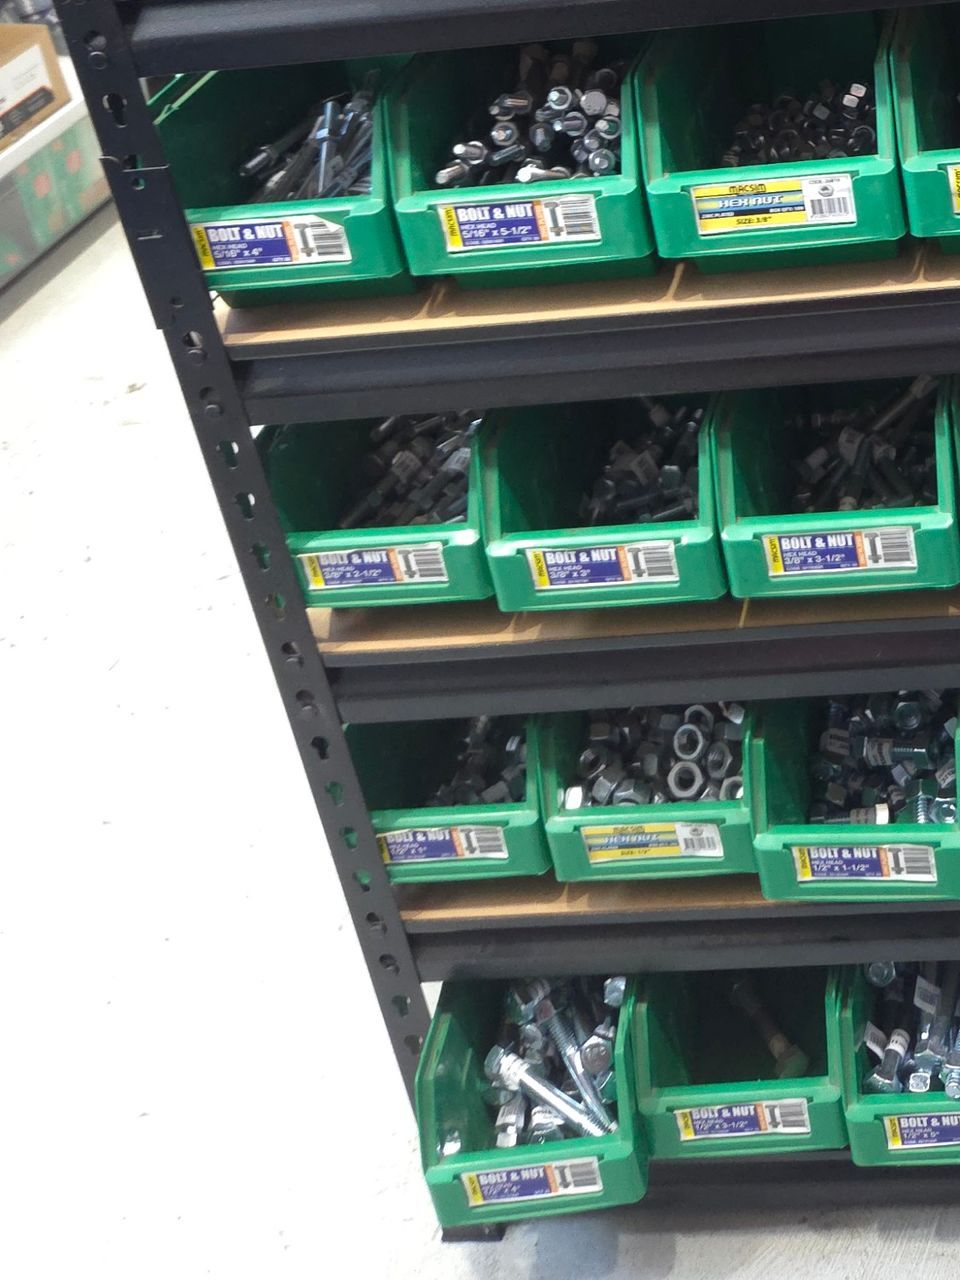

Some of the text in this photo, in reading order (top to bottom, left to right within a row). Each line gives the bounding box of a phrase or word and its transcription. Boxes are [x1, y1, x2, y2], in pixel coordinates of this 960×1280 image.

[718, 193, 783, 208] HEX NUT
[457, 203, 533, 222] BOLT & NUT
[207, 223, 283, 242] BOLT & NUT
[781, 534, 853, 550] BOLT & NUT
[318, 551, 388, 564] BOLT & NUT
[545, 548, 617, 565] BOLT & NUT
[386, 827, 450, 842] BOLT & NUT
[810, 847, 877, 859] BOLT & NUT
[692, 1105, 755, 1120] BOLT & NUT
[900, 1117, 928, 1128] BOLT
[931, 1118, 940, 1127] &
[479, 1167, 544, 1185] BOLT & NUT
